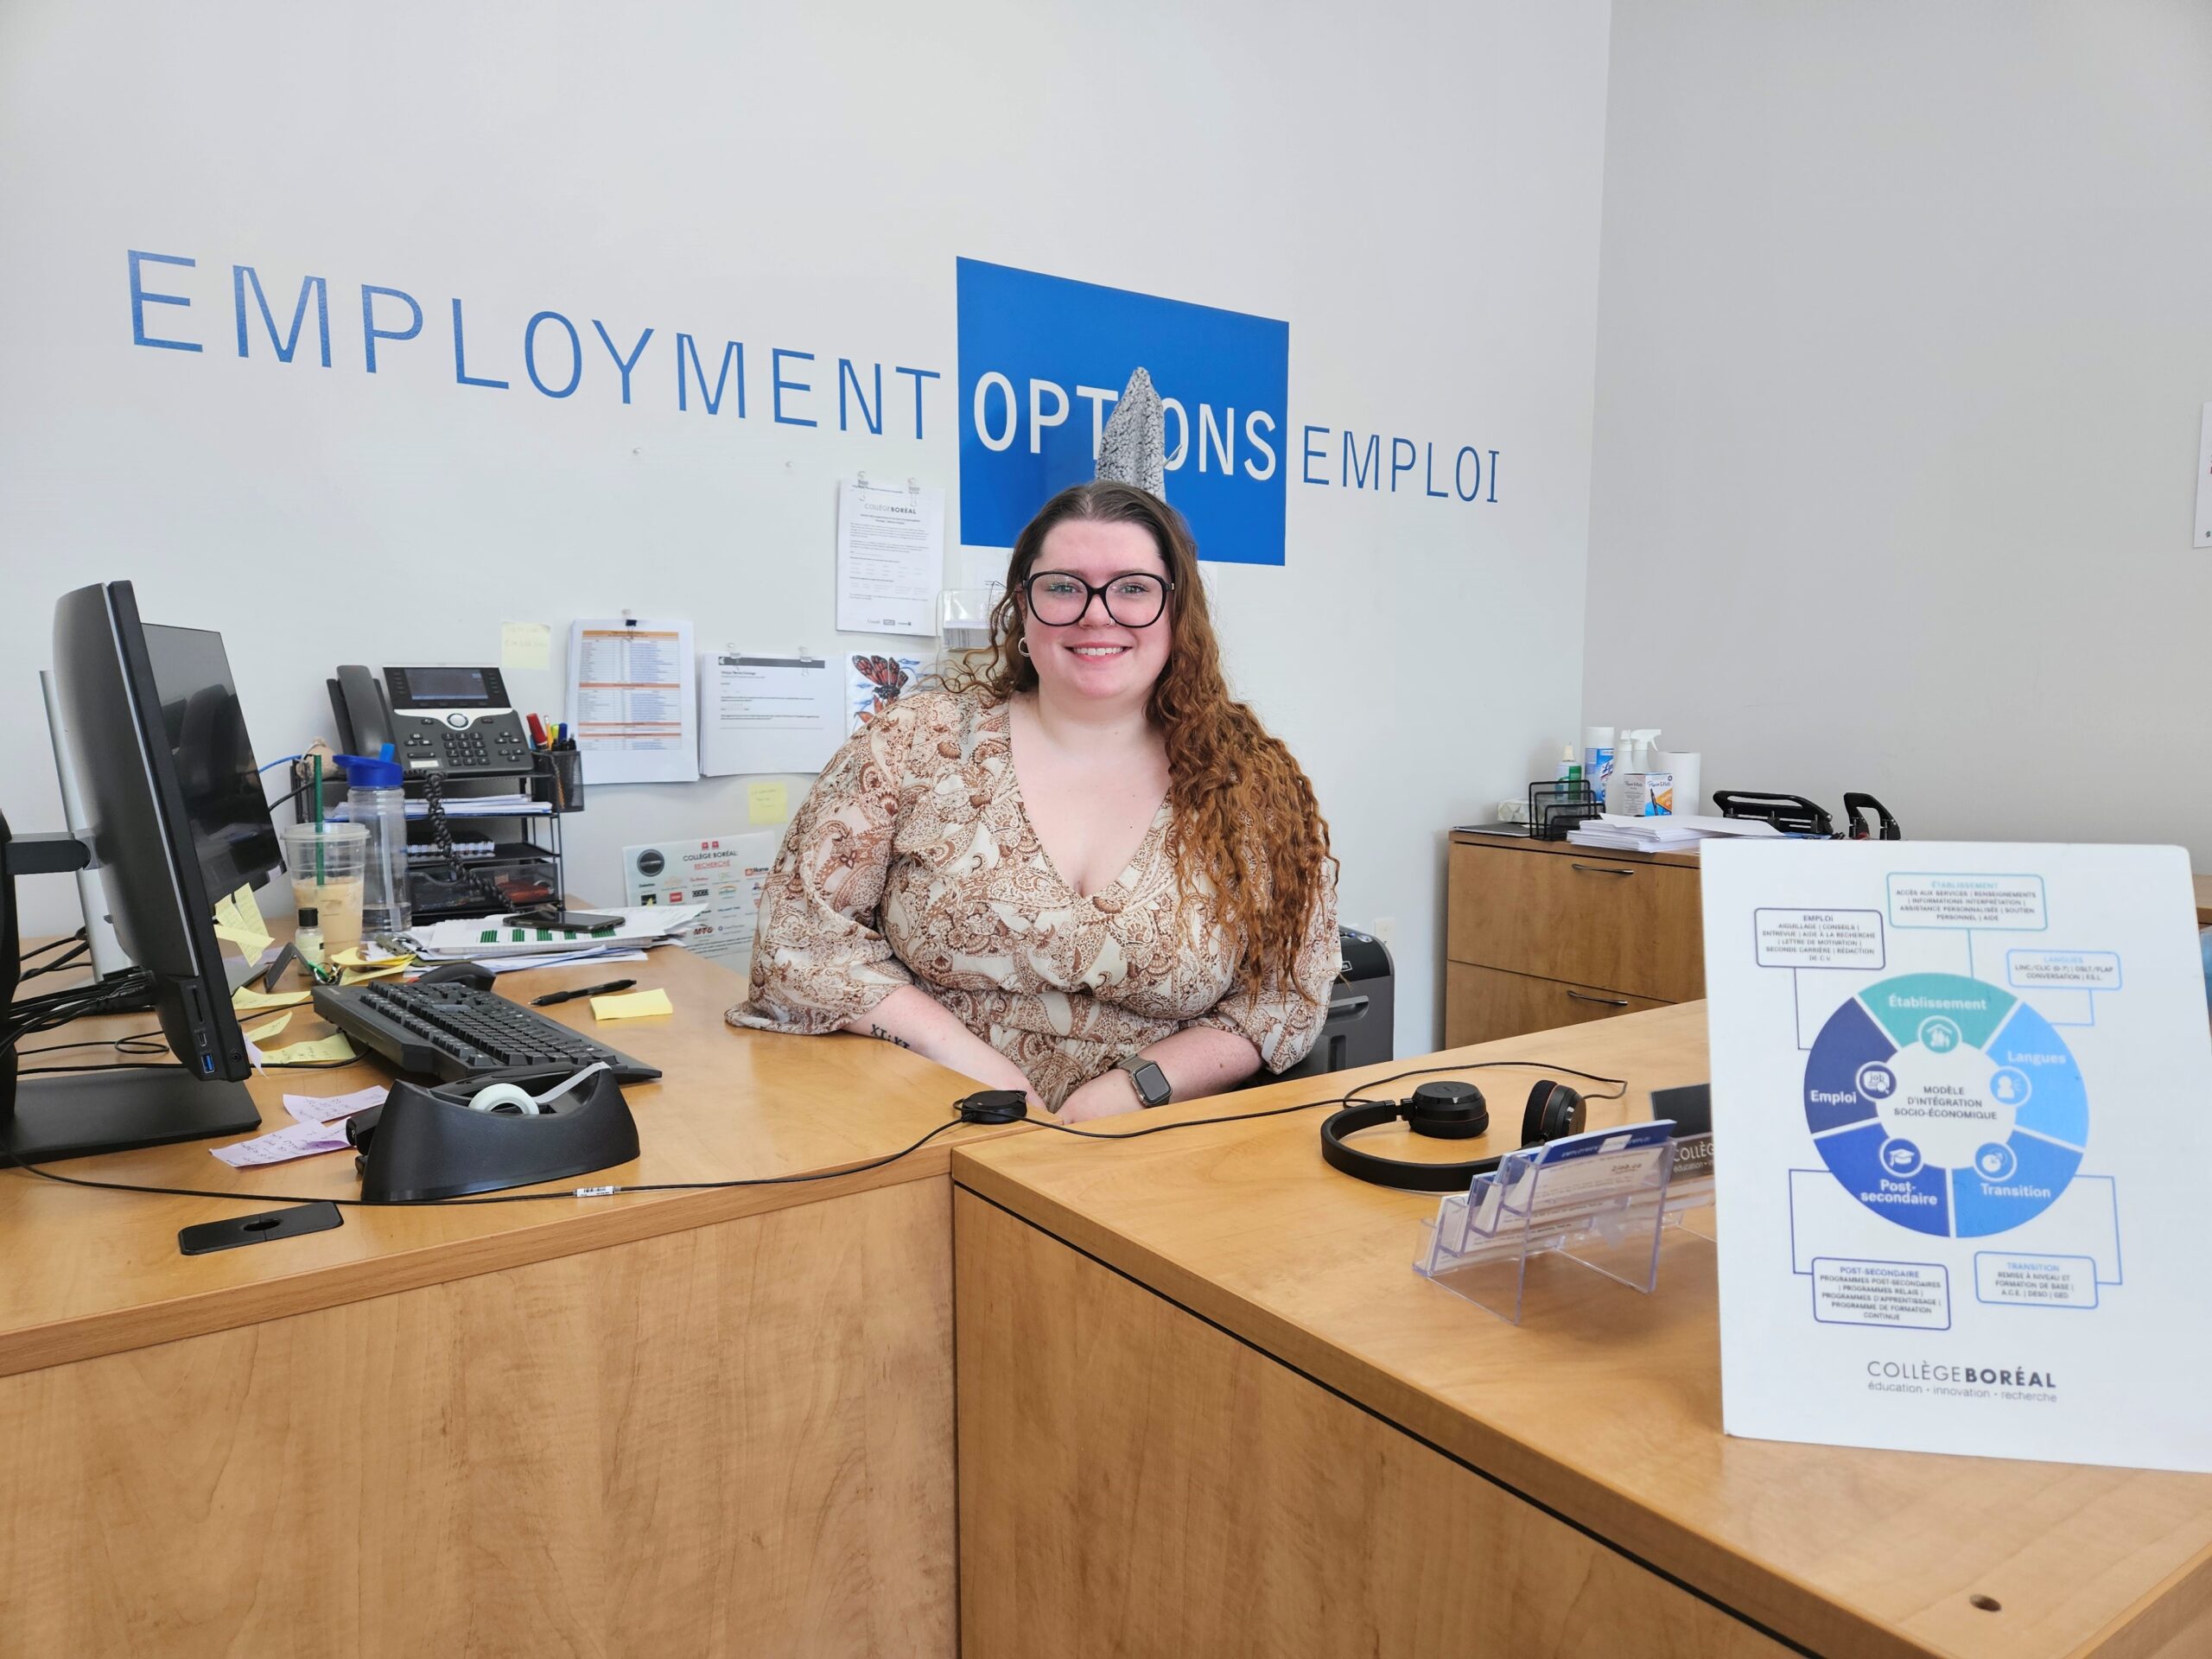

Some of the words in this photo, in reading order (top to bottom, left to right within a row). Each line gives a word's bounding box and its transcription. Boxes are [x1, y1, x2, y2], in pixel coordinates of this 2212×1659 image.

[128, 250, 940, 440] EMPLOYMENT
[974, 372, 1276, 480] OPTONS
[1303, 425, 1500, 504] EMPLOI
[1889, 995, 1987, 1011] Établissement
[2007, 1050, 2067, 1066] Langues
[1923, 1084, 1965, 1096] MODÈLE
[1810, 1090, 1858, 1105] Emploi
[1907, 1095, 1983, 1109] D'INTÉGRATION
[1894, 1107, 1998, 1121] SOCIO-ÉCONOMIQUE
[1674, 1141, 1714, 1162] COLLÈG
[1880, 1179, 1916, 1193] Post-
[1980, 1183, 2051, 1198] Transition
[1860, 1191, 1938, 1206] secondaire
[1840, 1266, 1920, 1279] POST-SECONDAIRE
[2007, 1262, 2060, 1272] TRANSITION
[1820, 1274, 1870, 1284] PROGRAMMES
[1998, 1271, 2024, 1280] REMISE
[2032, 1273, 2060, 1281] NIVEAU
[1995, 1280, 2037, 1288] FORMATION
[1821, 1293, 1872, 1301] PROGRAMMES
[1832, 1302, 1877, 1311] PROGRAMME
[1891, 1305, 1932, 1314] FORMATION
[1864, 1312, 1900, 1320] CONTINUE
[1868, 1381, 1923, 1394] éducation
[1933, 1386, 1991, 1398] innovation
[2001, 1390, 2057, 1403] recherche
